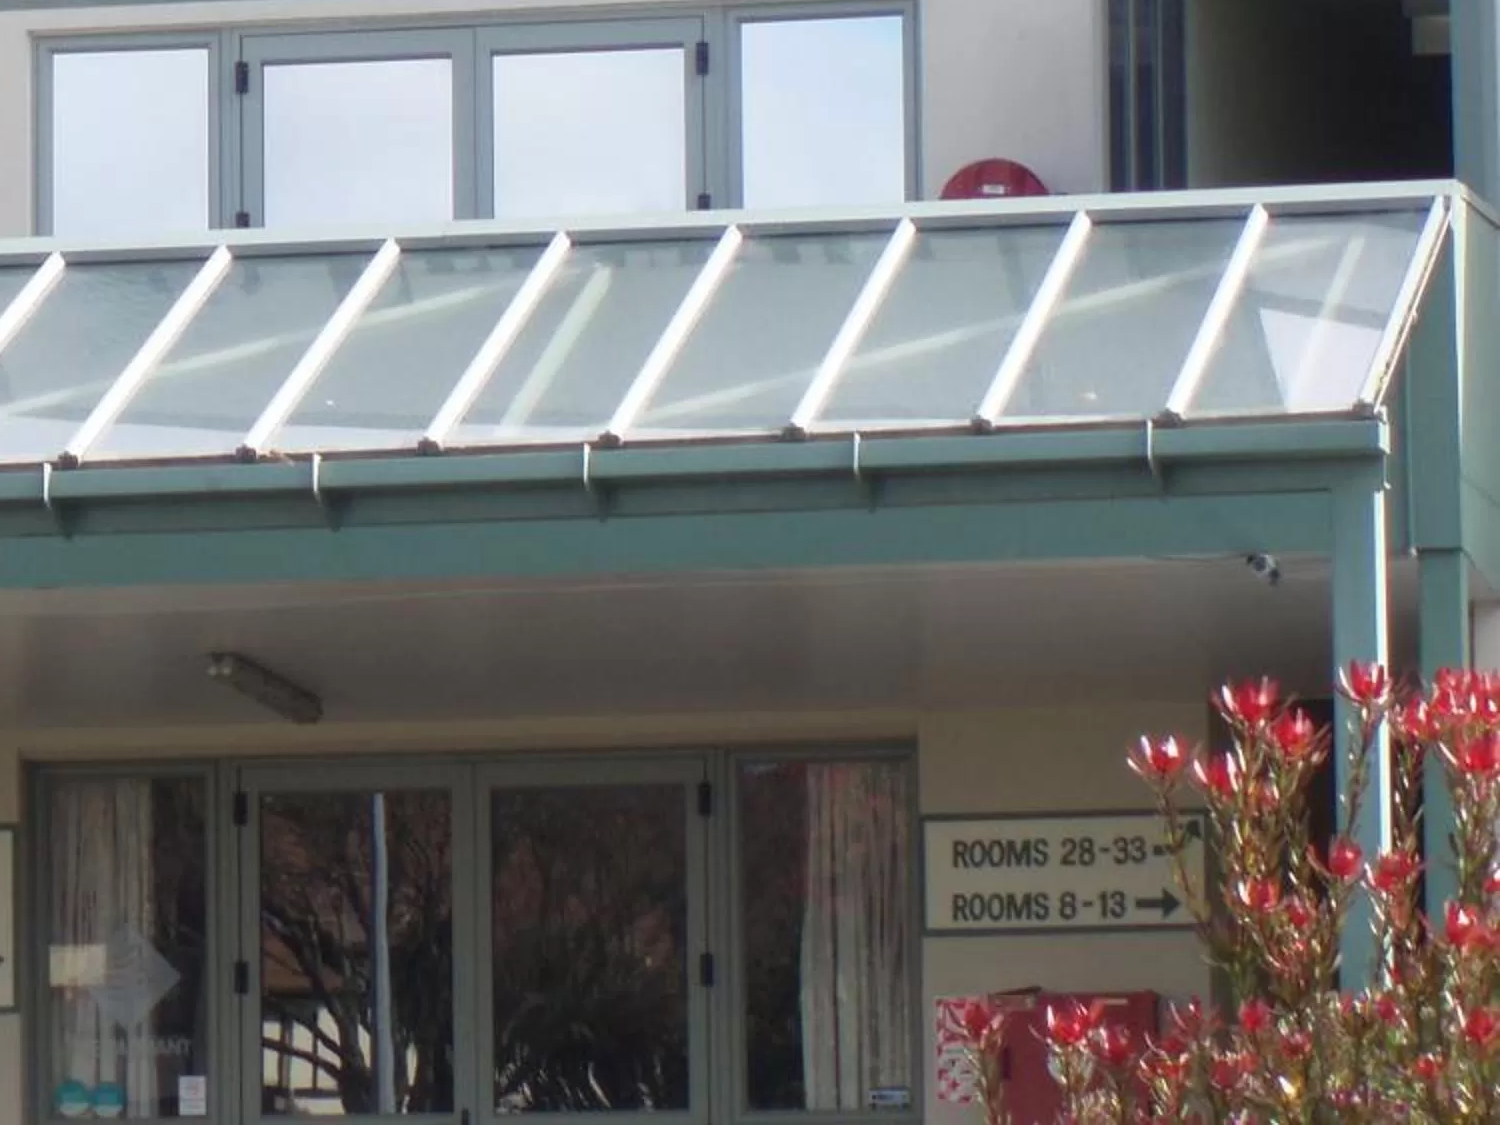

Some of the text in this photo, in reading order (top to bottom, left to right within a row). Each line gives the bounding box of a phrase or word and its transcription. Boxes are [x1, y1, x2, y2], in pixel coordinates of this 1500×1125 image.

[952, 836, 1148, 868] ROOMS 28-33
[952, 889, 1127, 922] ROOMS 8-13
